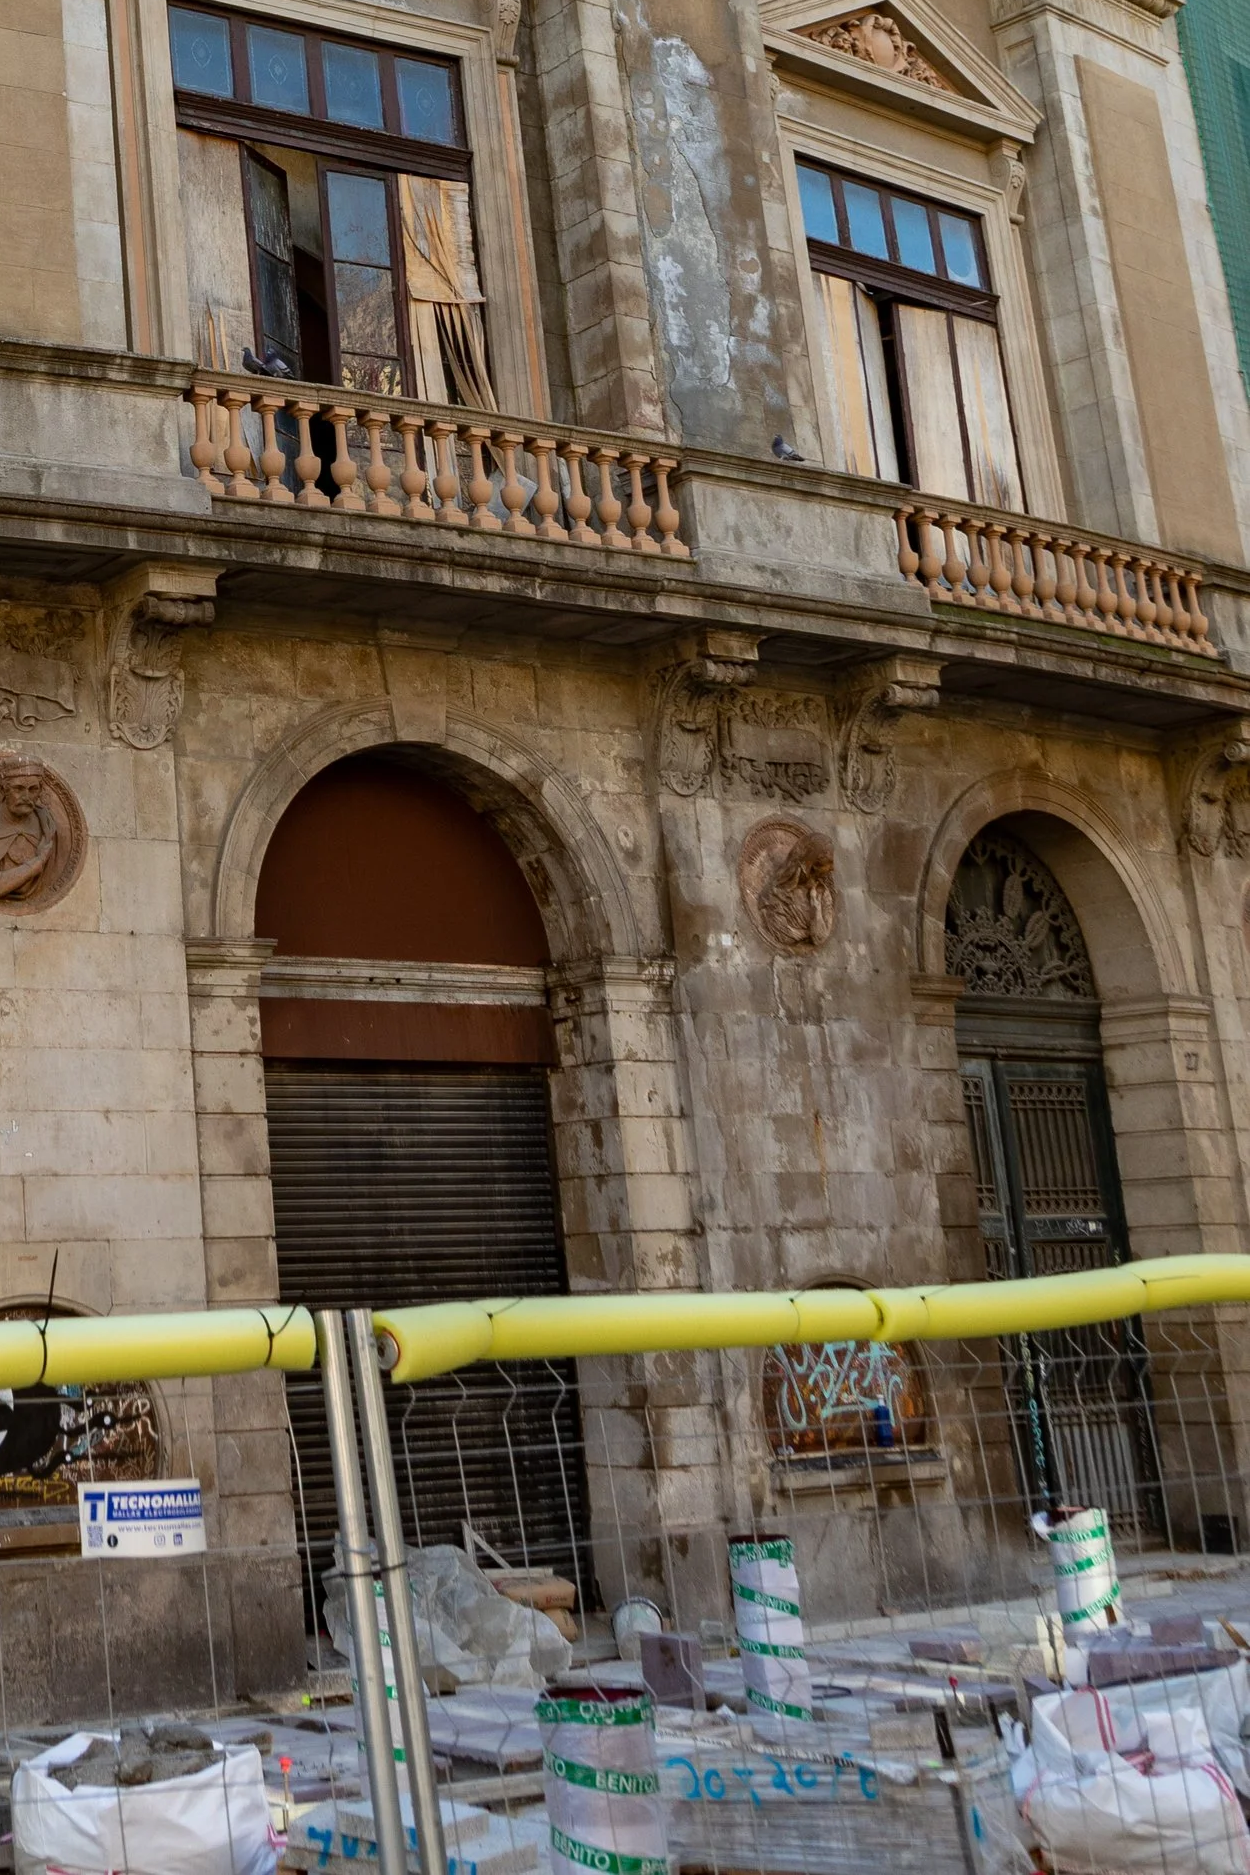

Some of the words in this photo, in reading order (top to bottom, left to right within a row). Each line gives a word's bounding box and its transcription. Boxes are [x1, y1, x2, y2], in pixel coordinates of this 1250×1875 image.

[1183, 1051, 1199, 1074] 27
[754, 1591, 791, 1613] BENITO
[751, 1692, 786, 1715] BENITO
[595, 1771, 656, 1794] BENITO
[553, 1828, 610, 1872] BENITO
